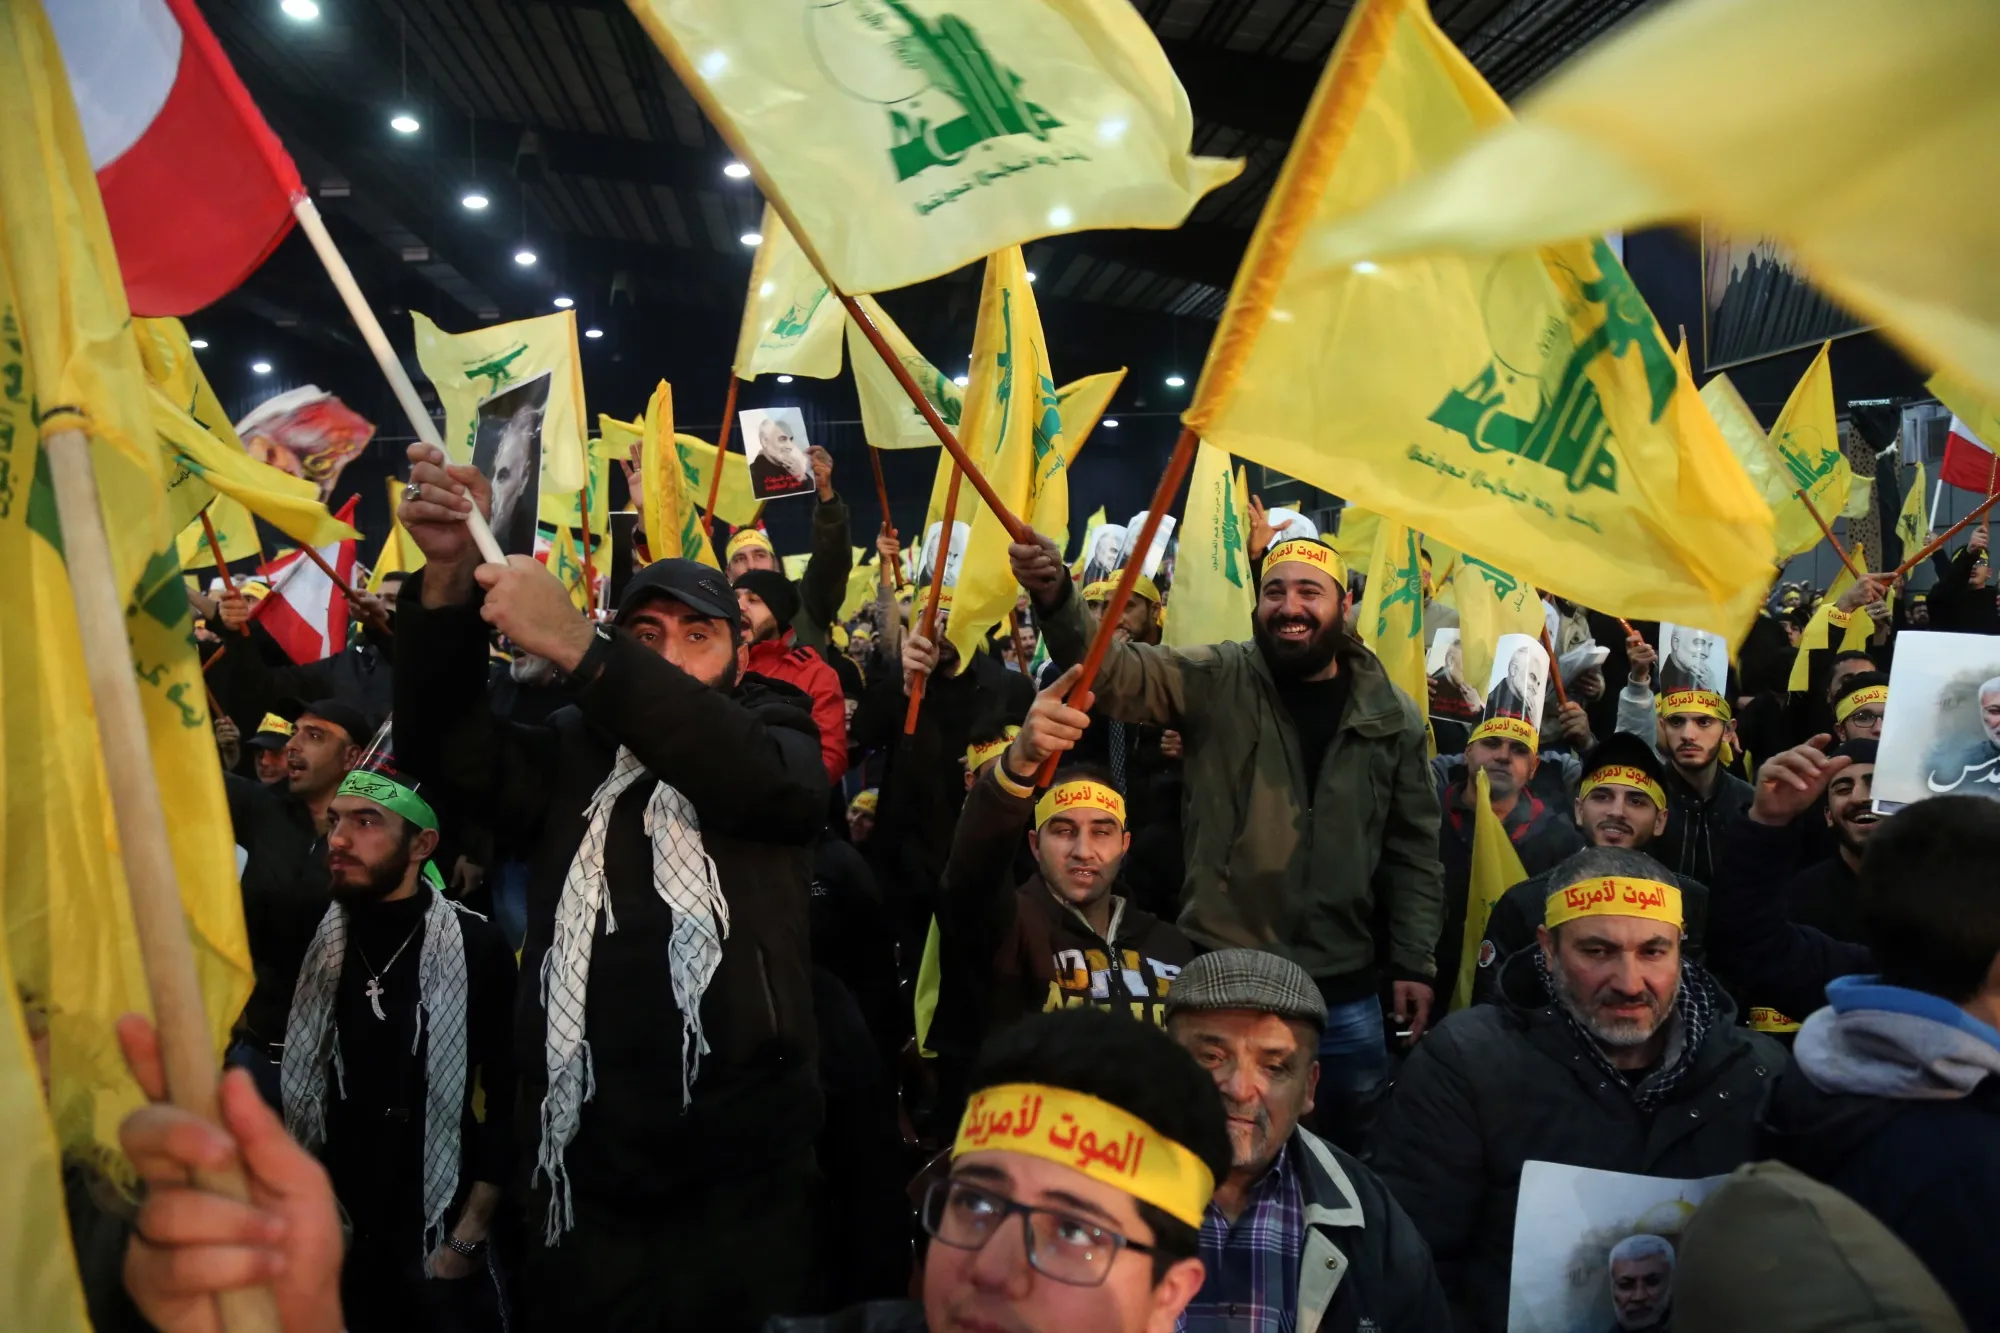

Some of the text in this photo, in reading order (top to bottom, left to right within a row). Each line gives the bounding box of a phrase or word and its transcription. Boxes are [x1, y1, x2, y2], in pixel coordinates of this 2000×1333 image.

[1267, 544, 1328, 566] الموت لأمريكا
[1667, 692, 1694, 707] لأمريكا
[1698, 693, 1721, 709] الموت
[1511, 722, 1532, 738] الموت
[1625, 766, 1653, 788] الموت
[1054, 786, 1120, 812] الموت لأمريكا
[1564, 882, 1666, 911] الموت لأمريكا
[963, 1094, 1146, 1177] الموت لأمريكا
